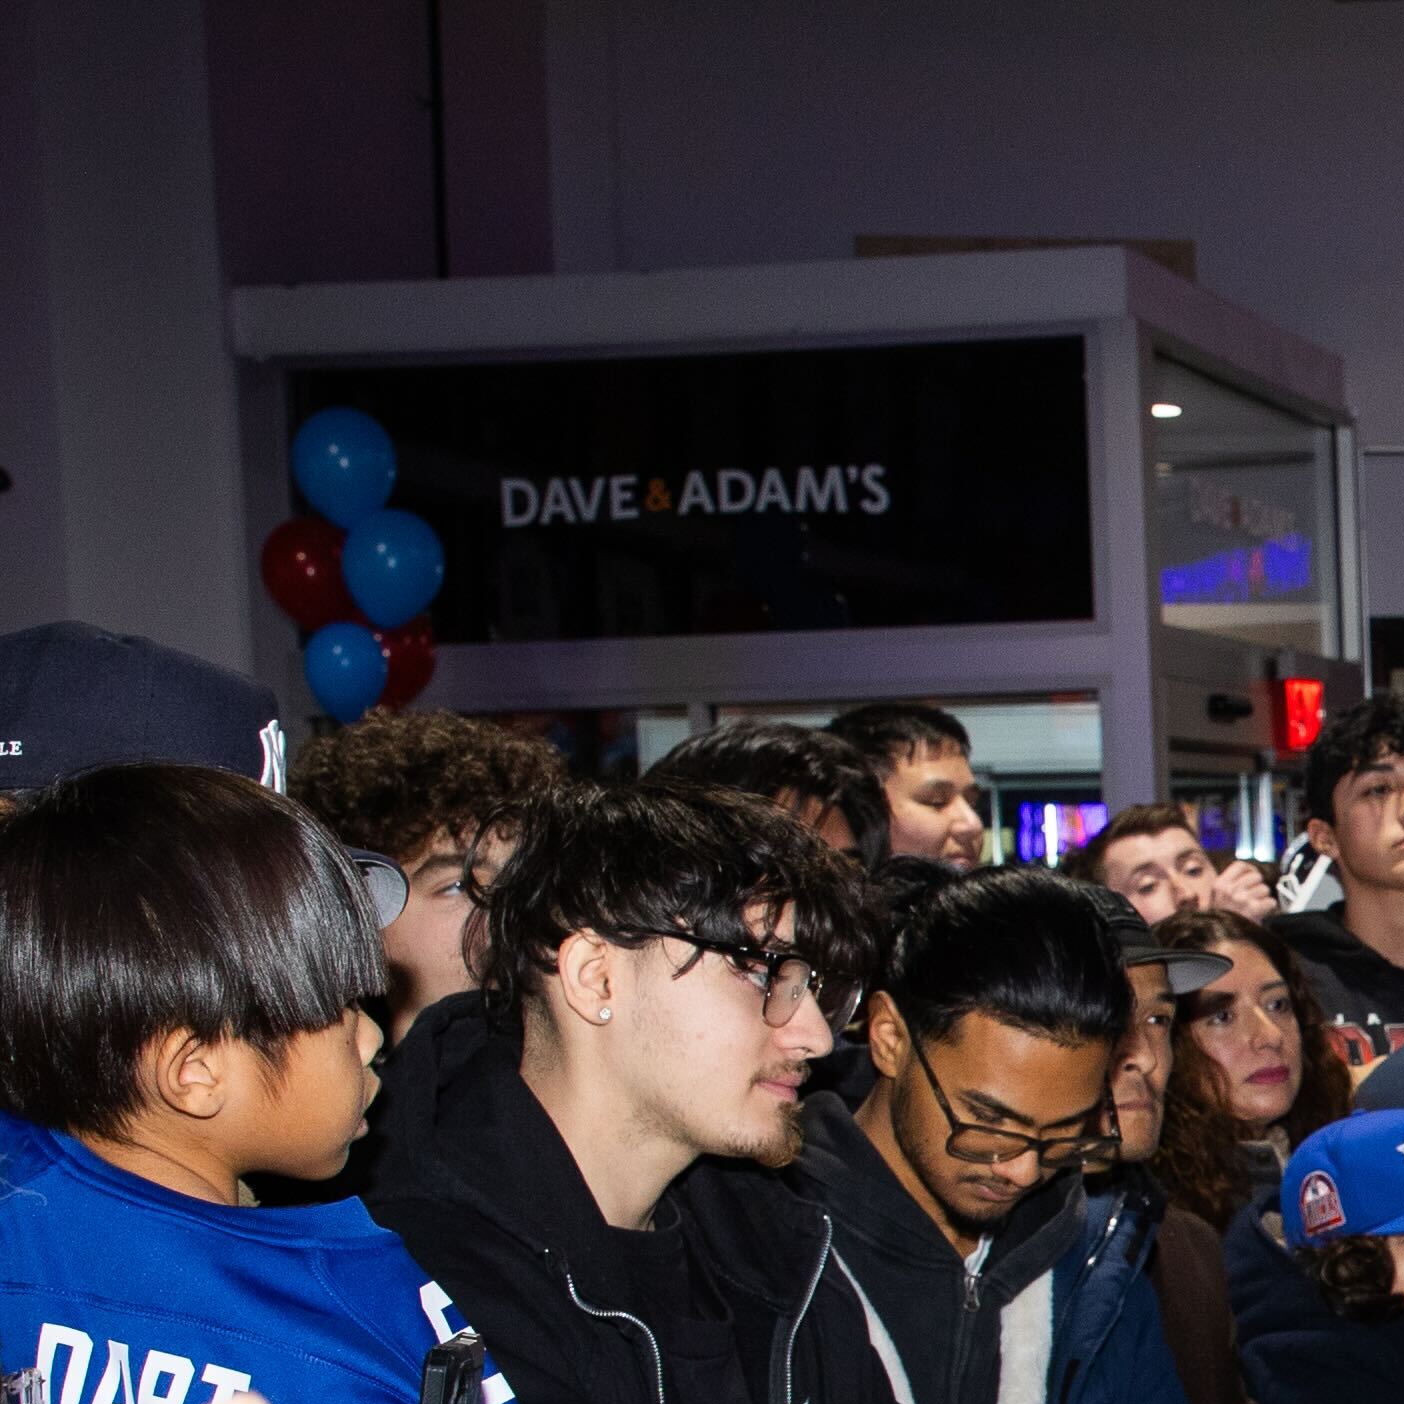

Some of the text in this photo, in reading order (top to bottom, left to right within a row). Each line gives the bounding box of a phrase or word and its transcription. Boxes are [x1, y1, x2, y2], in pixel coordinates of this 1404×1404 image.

[501, 464, 891, 527] DAVE & ADAM'S
